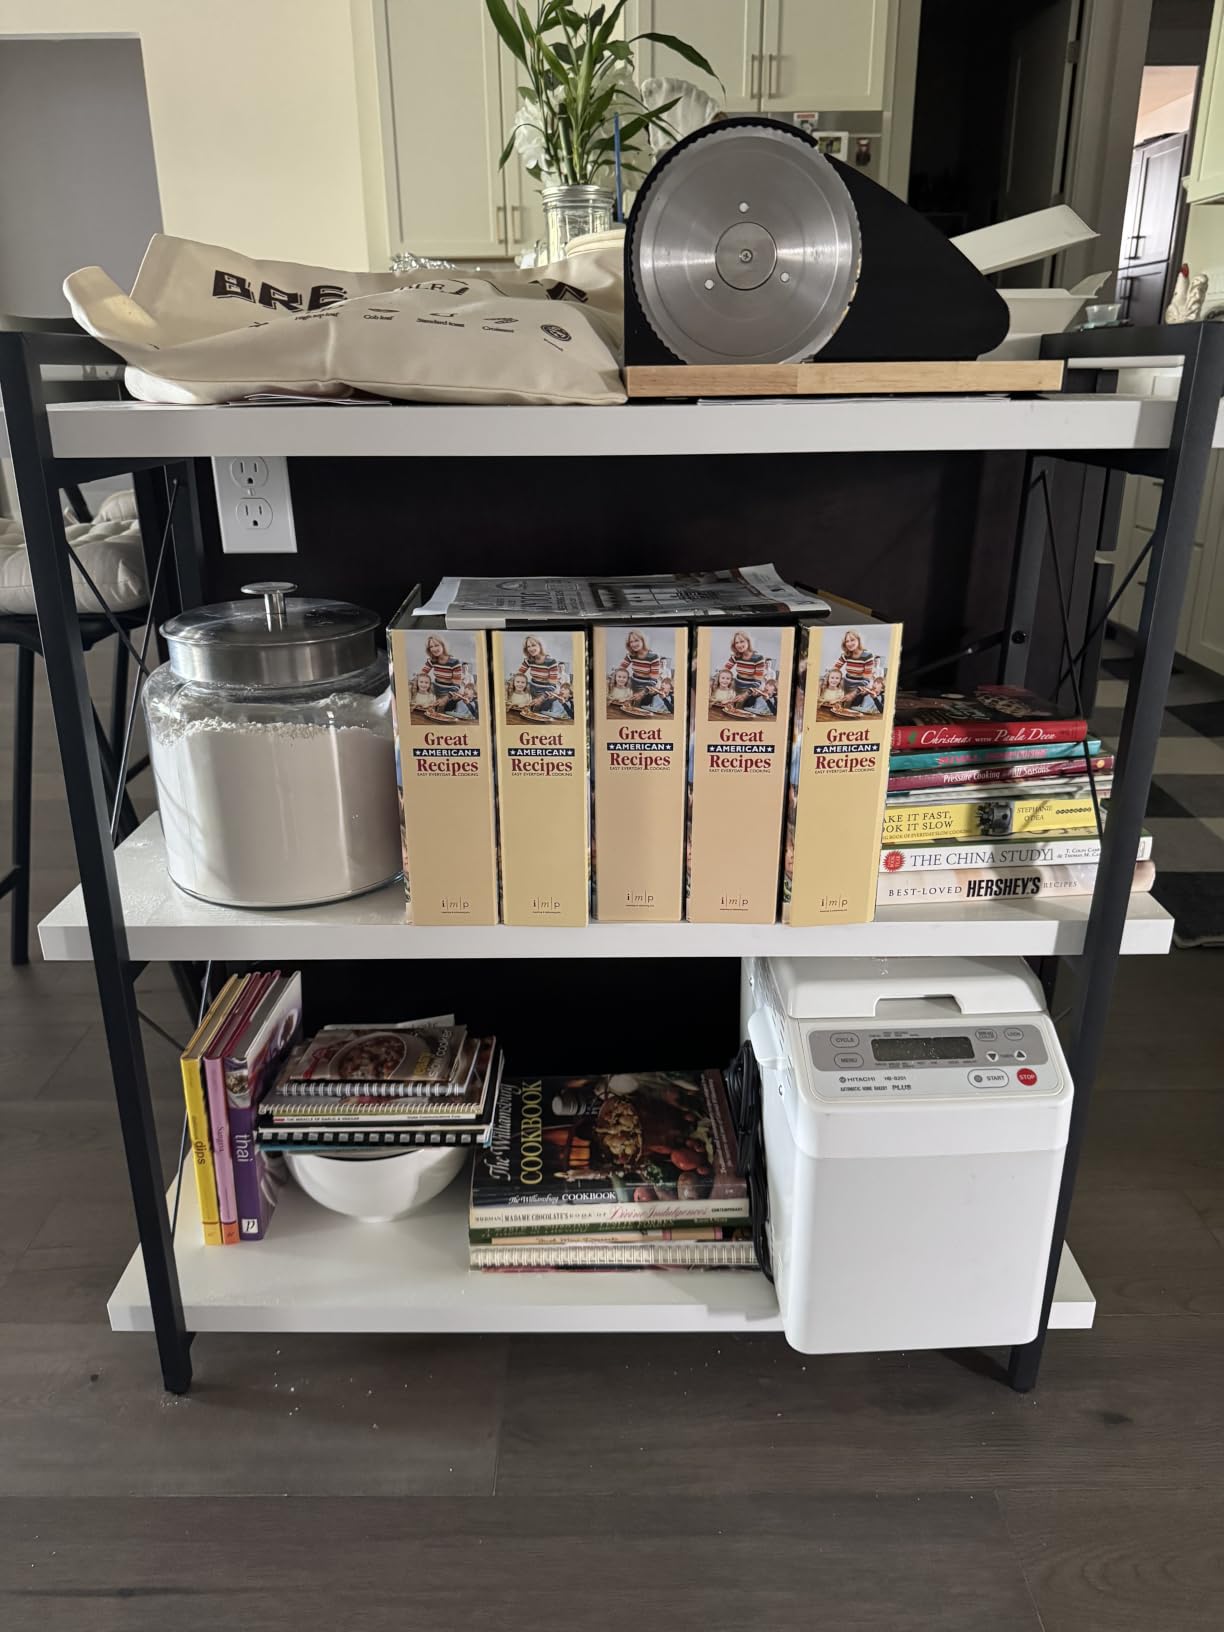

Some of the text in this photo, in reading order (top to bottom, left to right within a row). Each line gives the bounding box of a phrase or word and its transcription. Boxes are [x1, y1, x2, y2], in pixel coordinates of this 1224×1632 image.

[424, 732, 468, 745] Great
[520, 731, 563, 745] Great
[619, 726, 662, 740] Great
[720, 728, 764, 742] Great
[827, 728, 870, 743] Great
[920, 727, 971, 745] Christmas
[994, 728, 1026, 742] Paula
[1028, 728, 1058, 741] Deen
[822, 745, 871, 753] AMERICAN
[417, 758, 479, 776] Recipes
[512, 758, 573, 776] Recipes
[610, 752, 671, 770] Recipes
[710, 755, 771, 772] Recipes
[815, 754, 876, 773] Recipes
[943, 774, 972, 784] Pressure
[973, 770, 1001, 781] Cooking
[1023, 765, 1051, 775] Seasons
[883, 811, 952, 824] AKE IT FAST,
[1017, 806, 1053, 814] STEPHANIE
[922, 821, 954, 831] SLOW
[910, 854, 942, 867] THE
[946, 852, 995, 866] CHINA
[1001, 849, 1051, 863] STUDY
[889, 876, 1078, 898] BEST-LOVED HERSHEY'S RECIPES
[1019, 1073, 1035, 1081] STOP
[892, 1084, 912, 1092] PLUS
[484, 1083, 521, 1182] The Williamsburg
[520, 1080, 543, 1185] COOKBOOK
[194, 1140, 206, 1165] dips
[235, 1134, 253, 1162] thai
[562, 1191, 616, 1201] COOKBOOK
